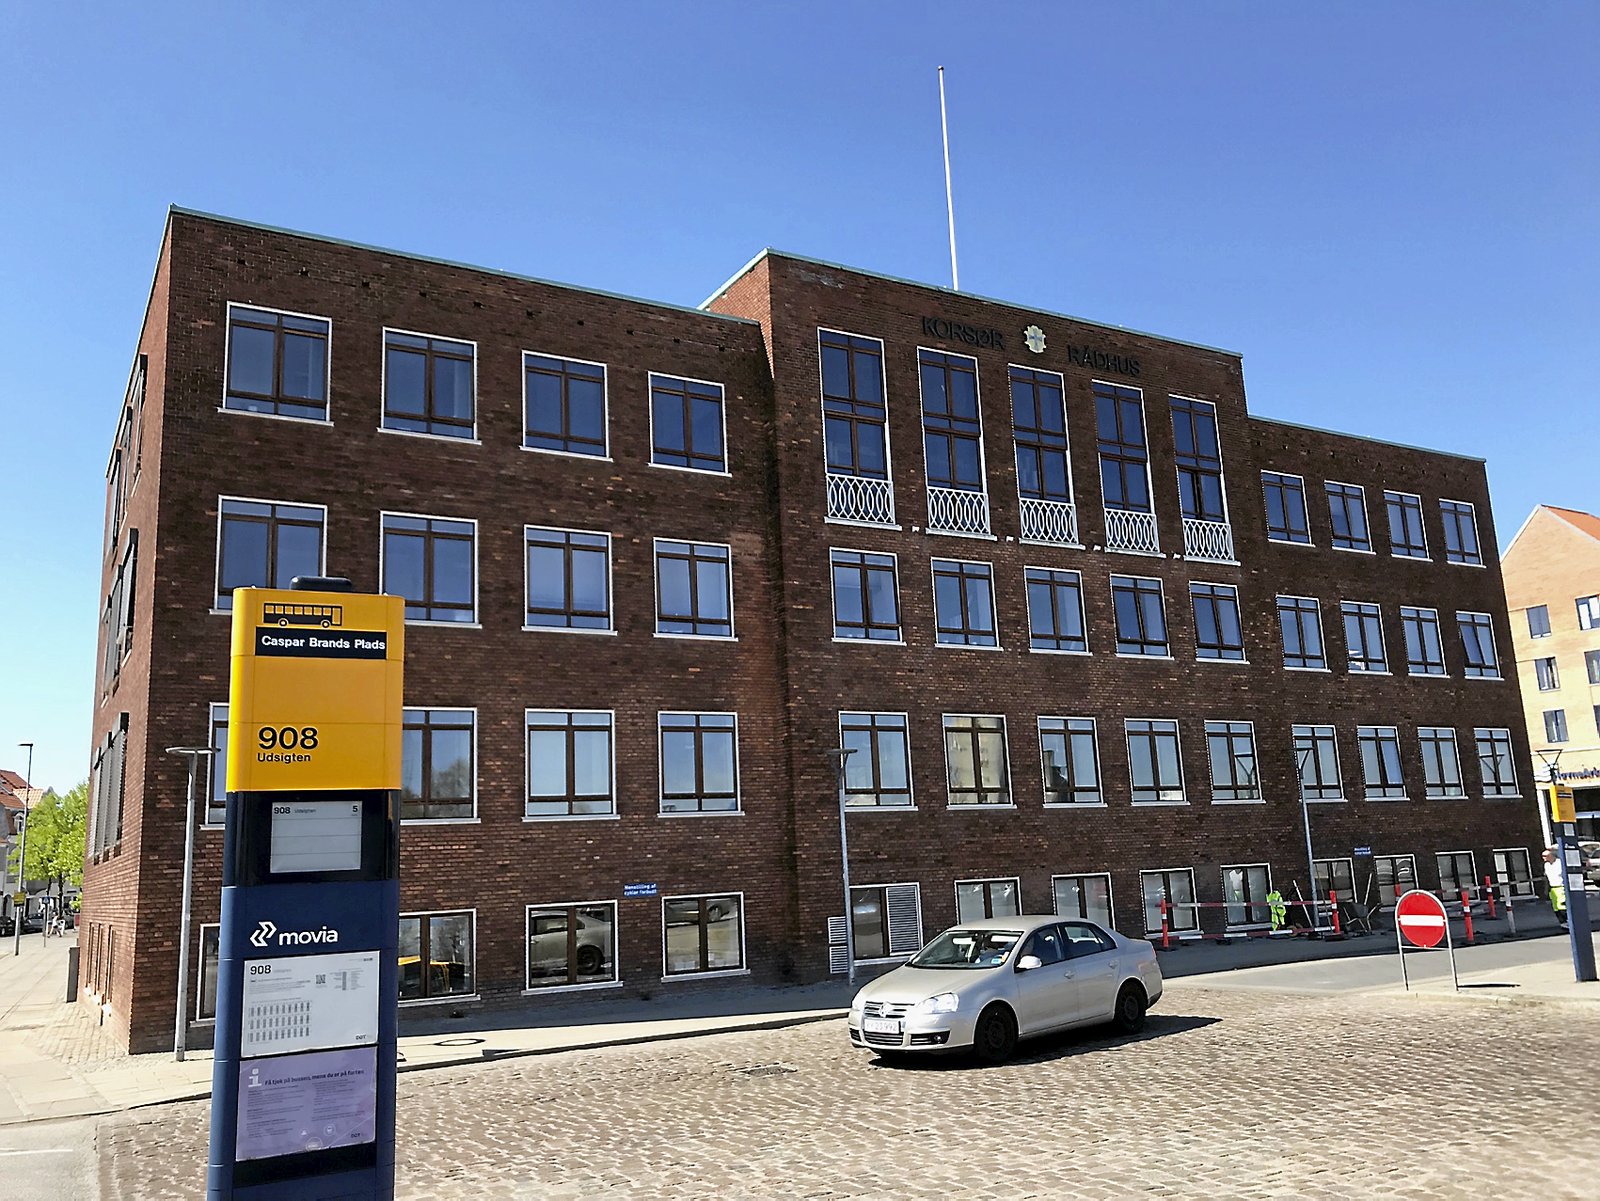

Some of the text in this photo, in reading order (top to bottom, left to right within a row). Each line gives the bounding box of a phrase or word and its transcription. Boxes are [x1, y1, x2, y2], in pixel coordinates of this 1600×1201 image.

[922, 316, 1141, 376] KORSØR RÅDHUS
[261, 635, 386, 650] Caspar Brands Plads
[258, 726, 319, 750] 908
[257, 752, 311, 764] Udsigten
[273, 806, 291, 815] 908
[352, 805, 359, 813] 5
[278, 925, 339, 946] movia
[250, 964, 272, 975] 908
